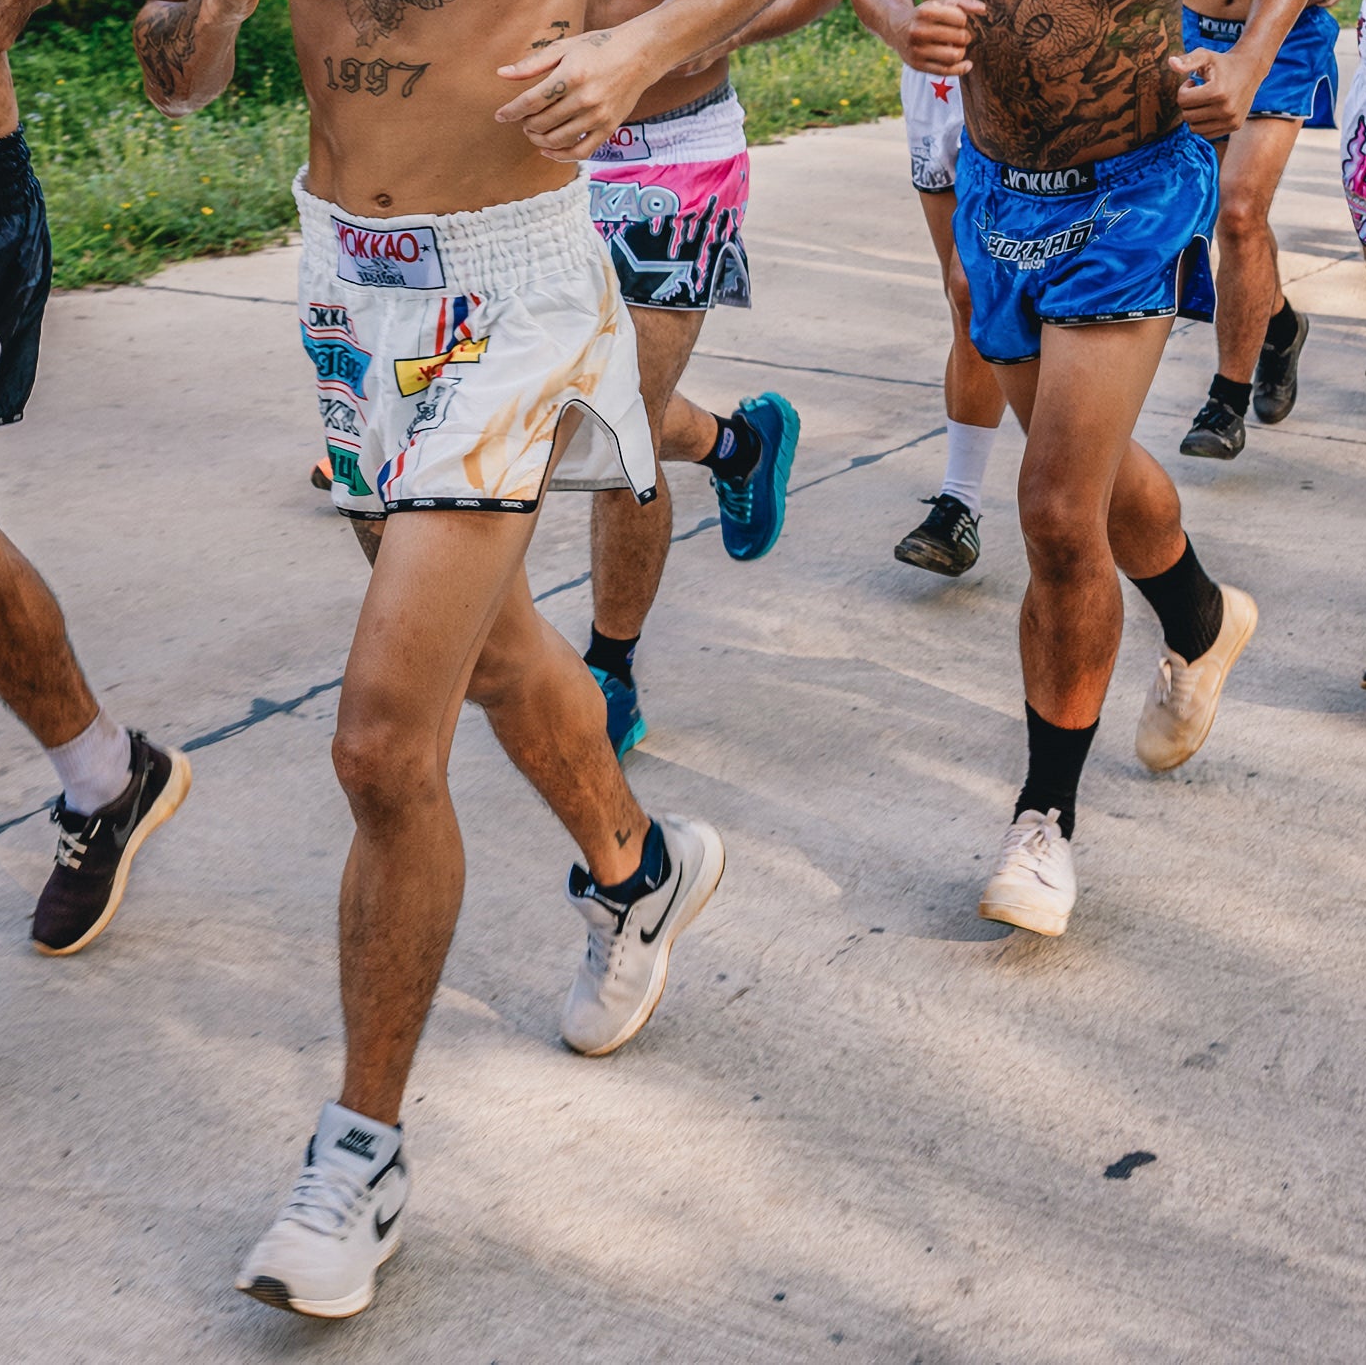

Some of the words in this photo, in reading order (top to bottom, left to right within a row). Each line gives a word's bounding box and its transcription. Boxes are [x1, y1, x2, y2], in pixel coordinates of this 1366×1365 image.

[324, 56, 432, 98] 1997
[1007, 168, 1081, 192] YOKKAO
[590, 184, 678, 222] KAO
[336, 222, 420, 263] YOKKAO
[309, 307, 352, 335] OKKA
